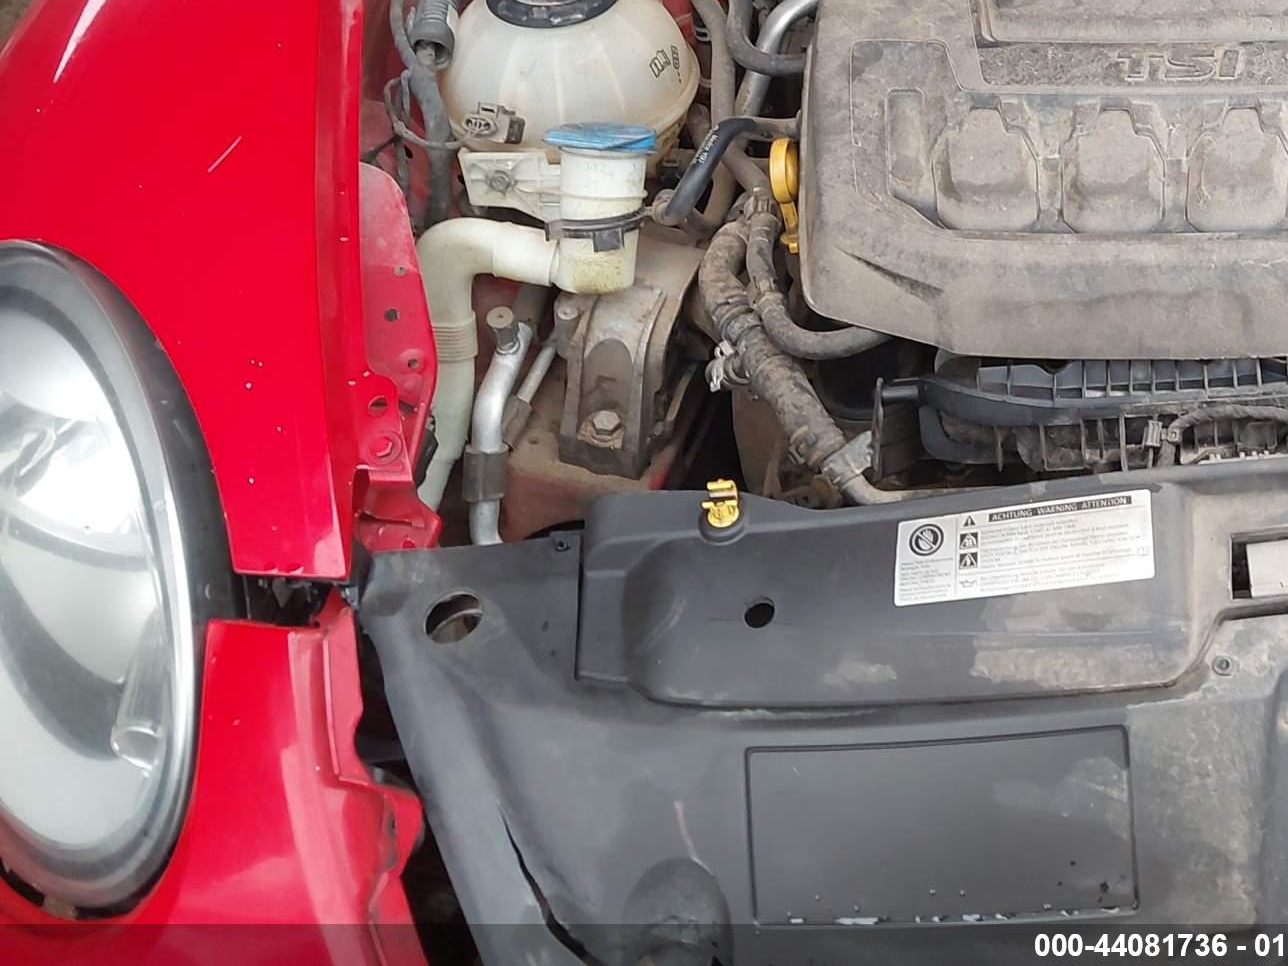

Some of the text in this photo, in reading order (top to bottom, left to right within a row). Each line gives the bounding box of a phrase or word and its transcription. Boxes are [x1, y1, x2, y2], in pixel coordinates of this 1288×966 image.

[1116, 48, 1242, 82] TSI
[992, 509, 1033, 522] ACHTUNG
[1037, 503, 1078, 515] WARNING
